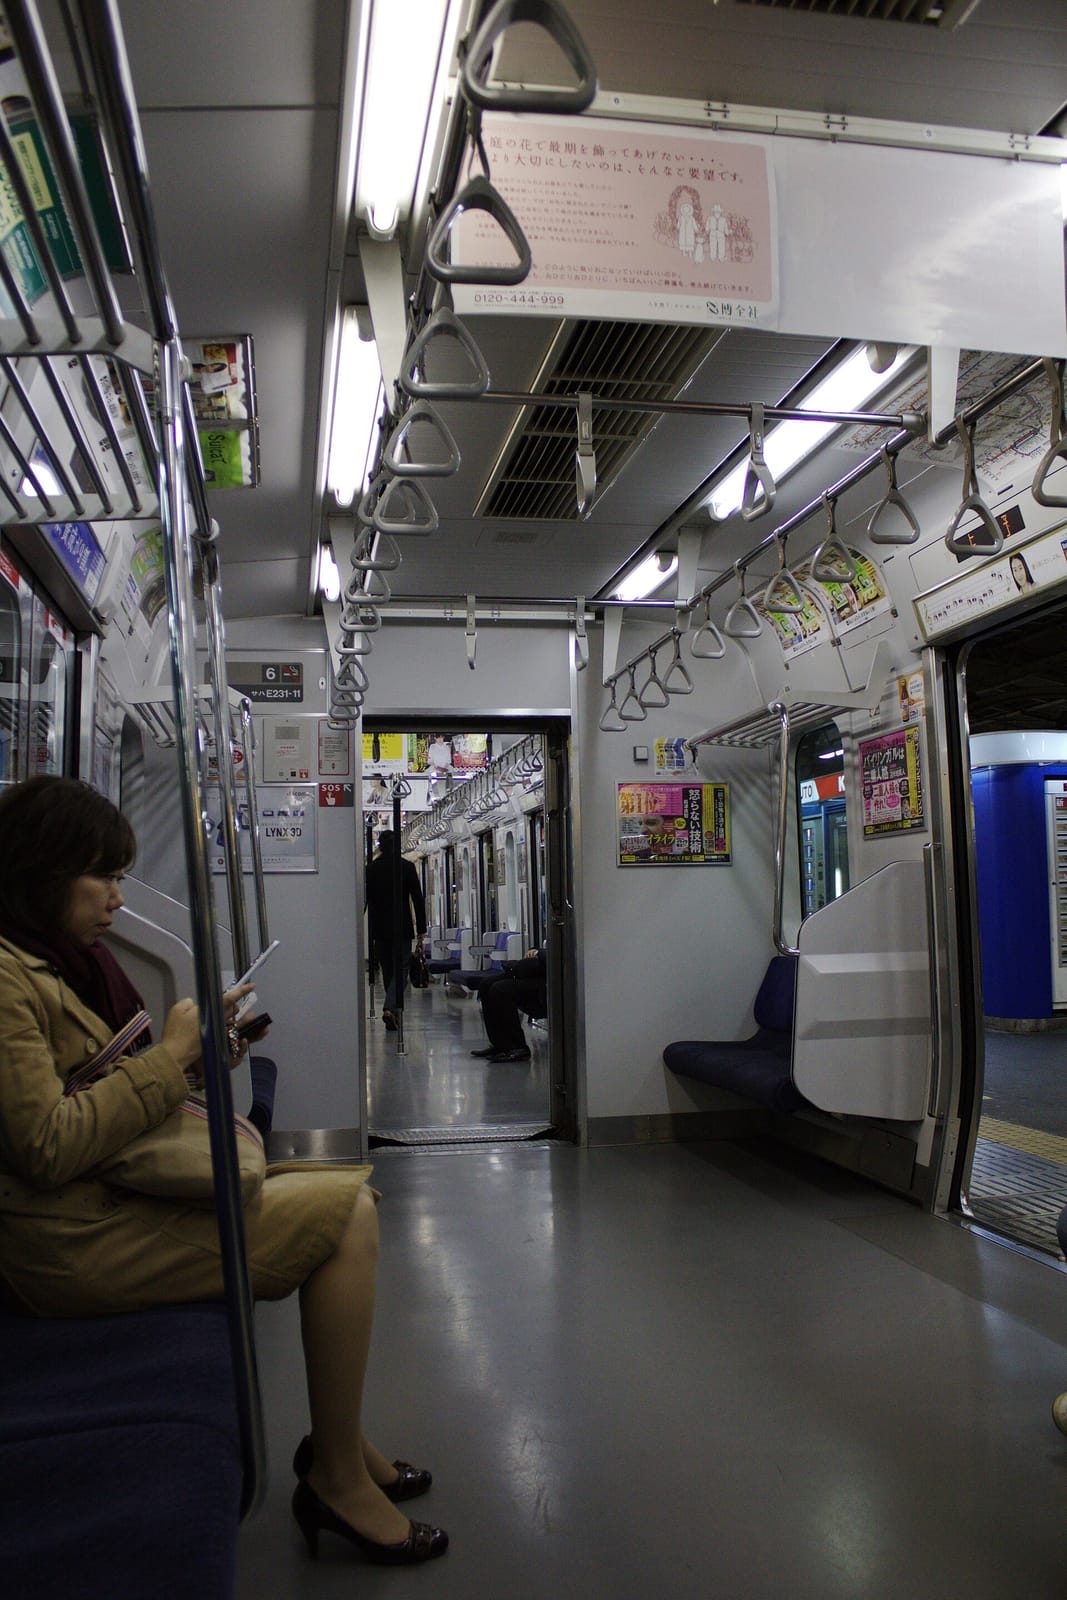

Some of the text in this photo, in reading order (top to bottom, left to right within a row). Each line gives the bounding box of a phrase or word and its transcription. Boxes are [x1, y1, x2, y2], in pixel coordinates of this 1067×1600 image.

[474, 294, 564, 305] 0120-444-999
[265, 667, 276, 681] 6
[251, 689, 301, 698] サハE231-11
[321, 784, 341, 792] SOS
[800, 785, 812, 799] TO
[689, 789, 701, 853] 怒らない技術
[265, 827, 302, 837] LYNX 3D
[648, 834, 675, 845] イライラ
